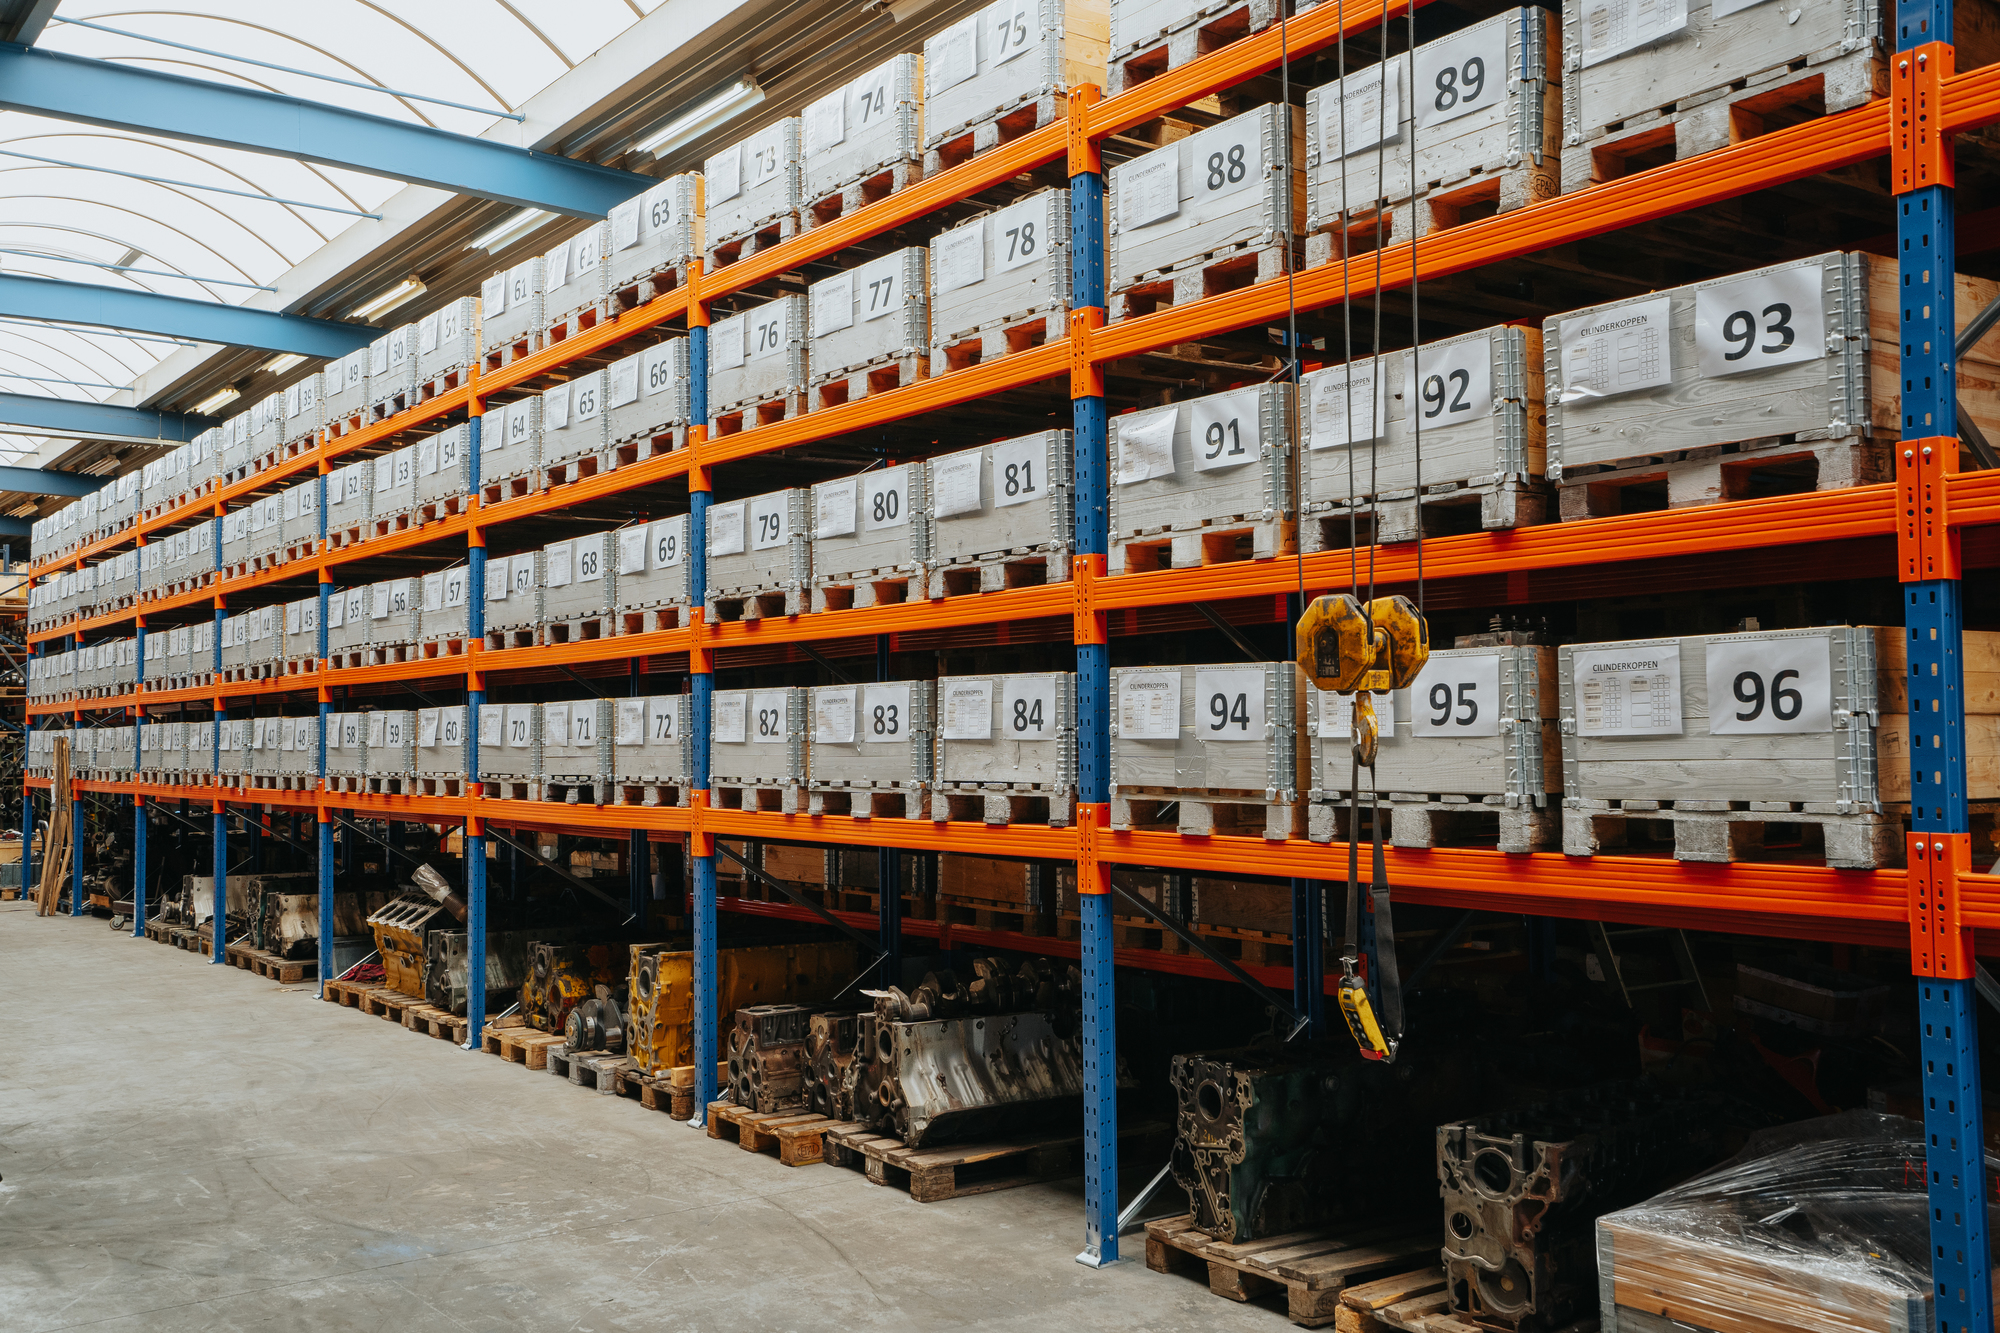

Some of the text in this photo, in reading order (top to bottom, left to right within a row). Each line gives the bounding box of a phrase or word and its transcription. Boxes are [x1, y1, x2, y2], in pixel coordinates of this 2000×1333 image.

[998, 11, 1027, 54] 75
[1333, 79, 1385, 105] CILNDERKOPPEN
[1434, 56, 1485, 111] 89
[860, 86, 885, 124] 74
[1207, 143, 1246, 191] 88
[651, 198, 670, 228] 63
[1005, 221, 1035, 262] 78
[514, 276, 527, 302] 61
[868, 275, 894, 312] 77
[757, 319, 778, 352] 76
[1580, 315, 1647, 337] CILINDERKOPPEN
[1722, 302, 1795, 361] 93
[349, 364, 359, 383] 49
[650, 359, 668, 389] 66
[303, 388, 312, 407] 39
[579, 389, 595, 416] 65
[1422, 368, 1471, 418] 92
[512, 414, 524, 439] 64
[1205, 417, 1245, 460] 91
[444, 441, 456, 464] 54
[398, 460, 409, 482] 53
[1004, 459, 1036, 497] 81
[348, 475, 358, 495] 52
[267, 506, 275, 523] 41
[302, 493, 311, 510] 42
[872, 489, 899, 522] 80
[758, 512, 780, 543] 79
[658, 535, 676, 563] 69
[581, 551, 598, 576] 68
[449, 581, 461, 602] 57
[516, 568, 530, 592] 67
[350, 600, 359, 619] 55
[394, 592, 405, 612] 56
[304, 610, 313, 627] 45
[1592, 660, 1658, 672] CILINDERKOPPEN
[1129, 682, 1169, 690] CILINDERKOPPEN
[1733, 669, 1803, 722] 96
[1013, 698, 1044, 732] 84
[1210, 692, 1250, 731] 94
[1429, 682, 1478, 726] 95
[445, 720, 457, 742] 60
[512, 720, 525, 742] 70
[577, 716, 591, 741] 71
[656, 713, 672, 739] 72
[759, 708, 779, 737] 82
[873, 704, 899, 735] 83
[267, 729, 275, 745] 47
[297, 729, 306, 746] 48
[346, 725, 356, 744] 58
[389, 724, 399, 744] 59
